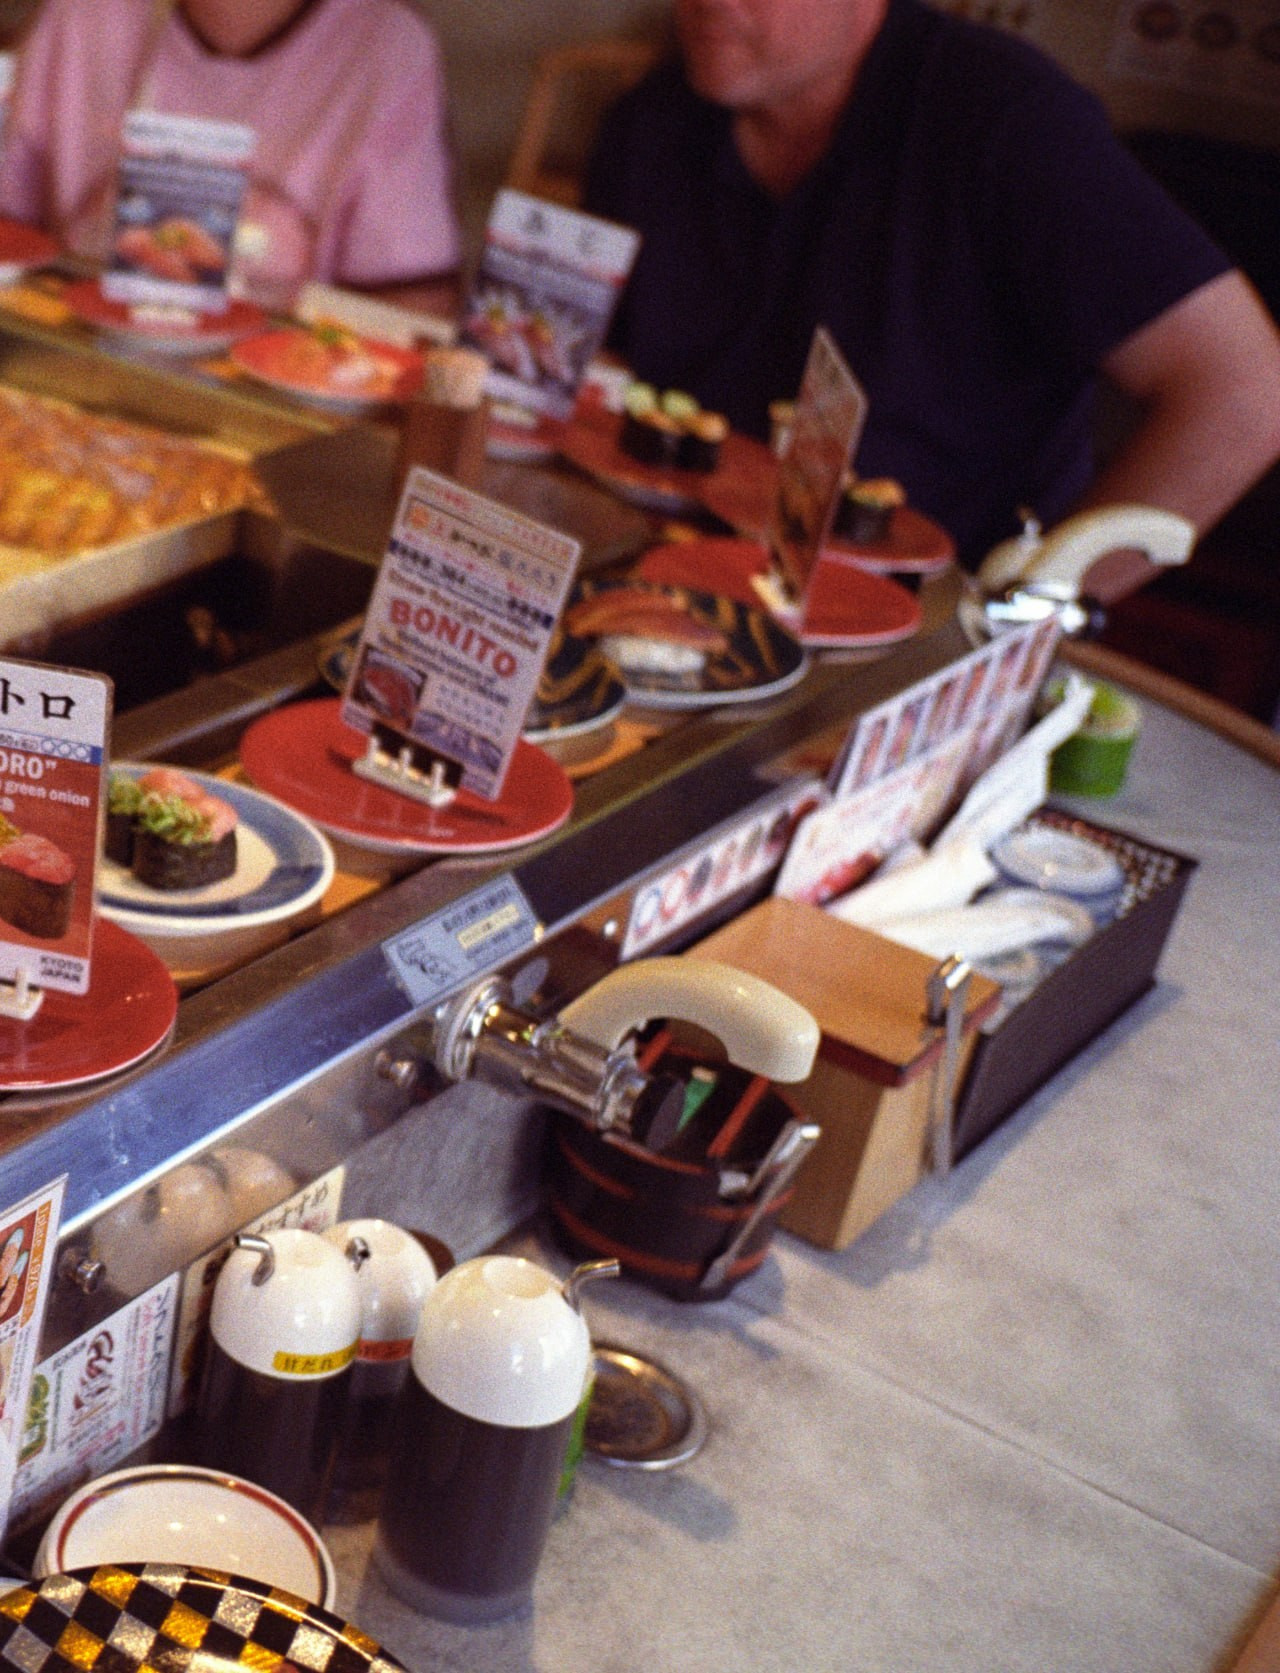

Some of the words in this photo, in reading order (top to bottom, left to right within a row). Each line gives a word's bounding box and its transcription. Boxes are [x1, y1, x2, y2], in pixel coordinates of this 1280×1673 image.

[390, 599, 517, 678] BONITO
[4, 781, 46, 799] green
[49, 789, 90, 808] onion
[40, 955, 83, 972] KYOTO
[41, 968, 80, 982] JAPAN
